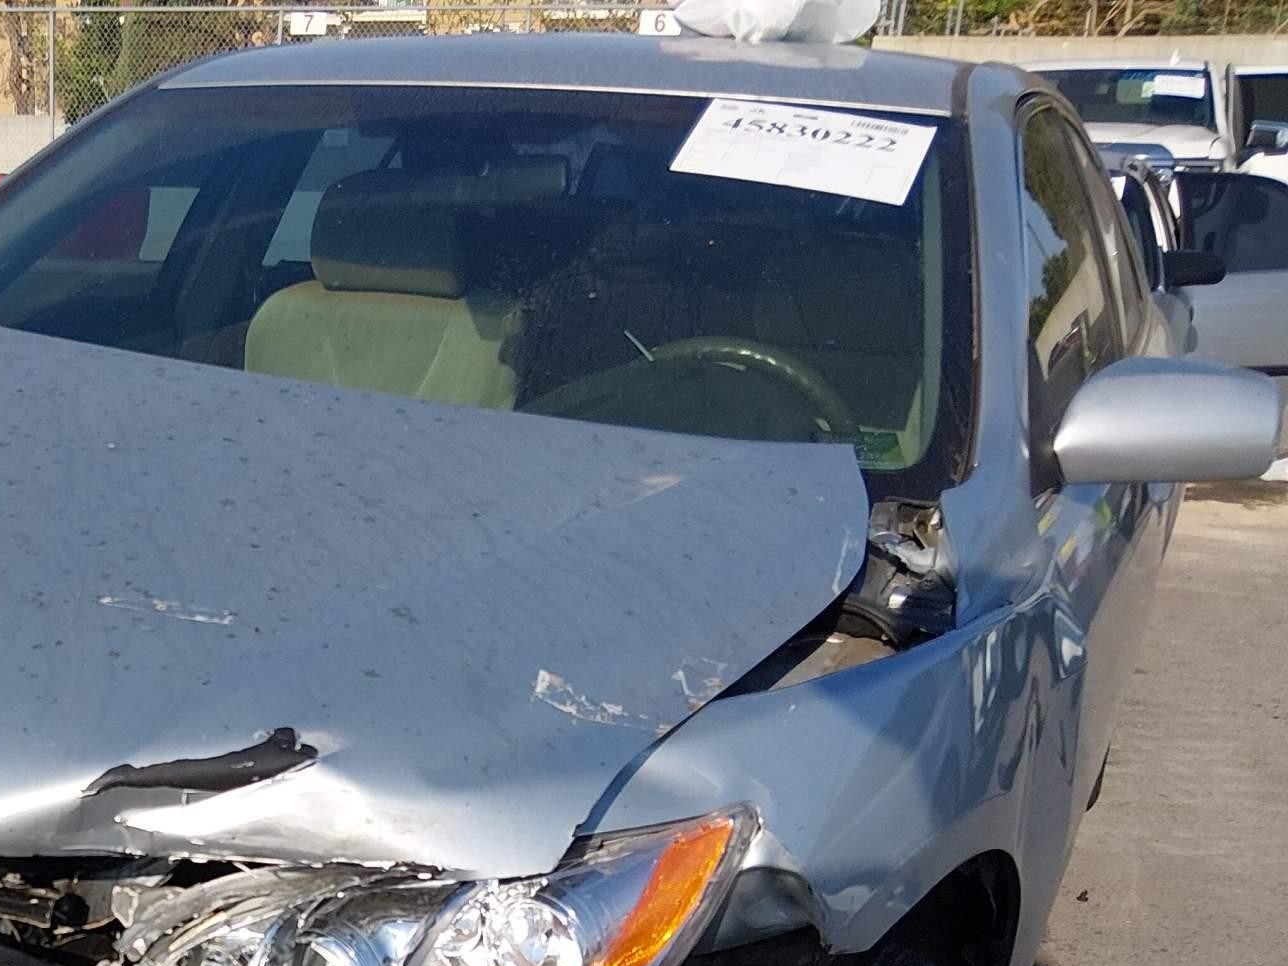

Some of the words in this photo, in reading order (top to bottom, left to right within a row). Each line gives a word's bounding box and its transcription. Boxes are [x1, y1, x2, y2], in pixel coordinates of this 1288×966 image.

[304, 15, 314, 32] 7
[655, 13, 666, 32] 6
[722, 116, 898, 153] 45830222
